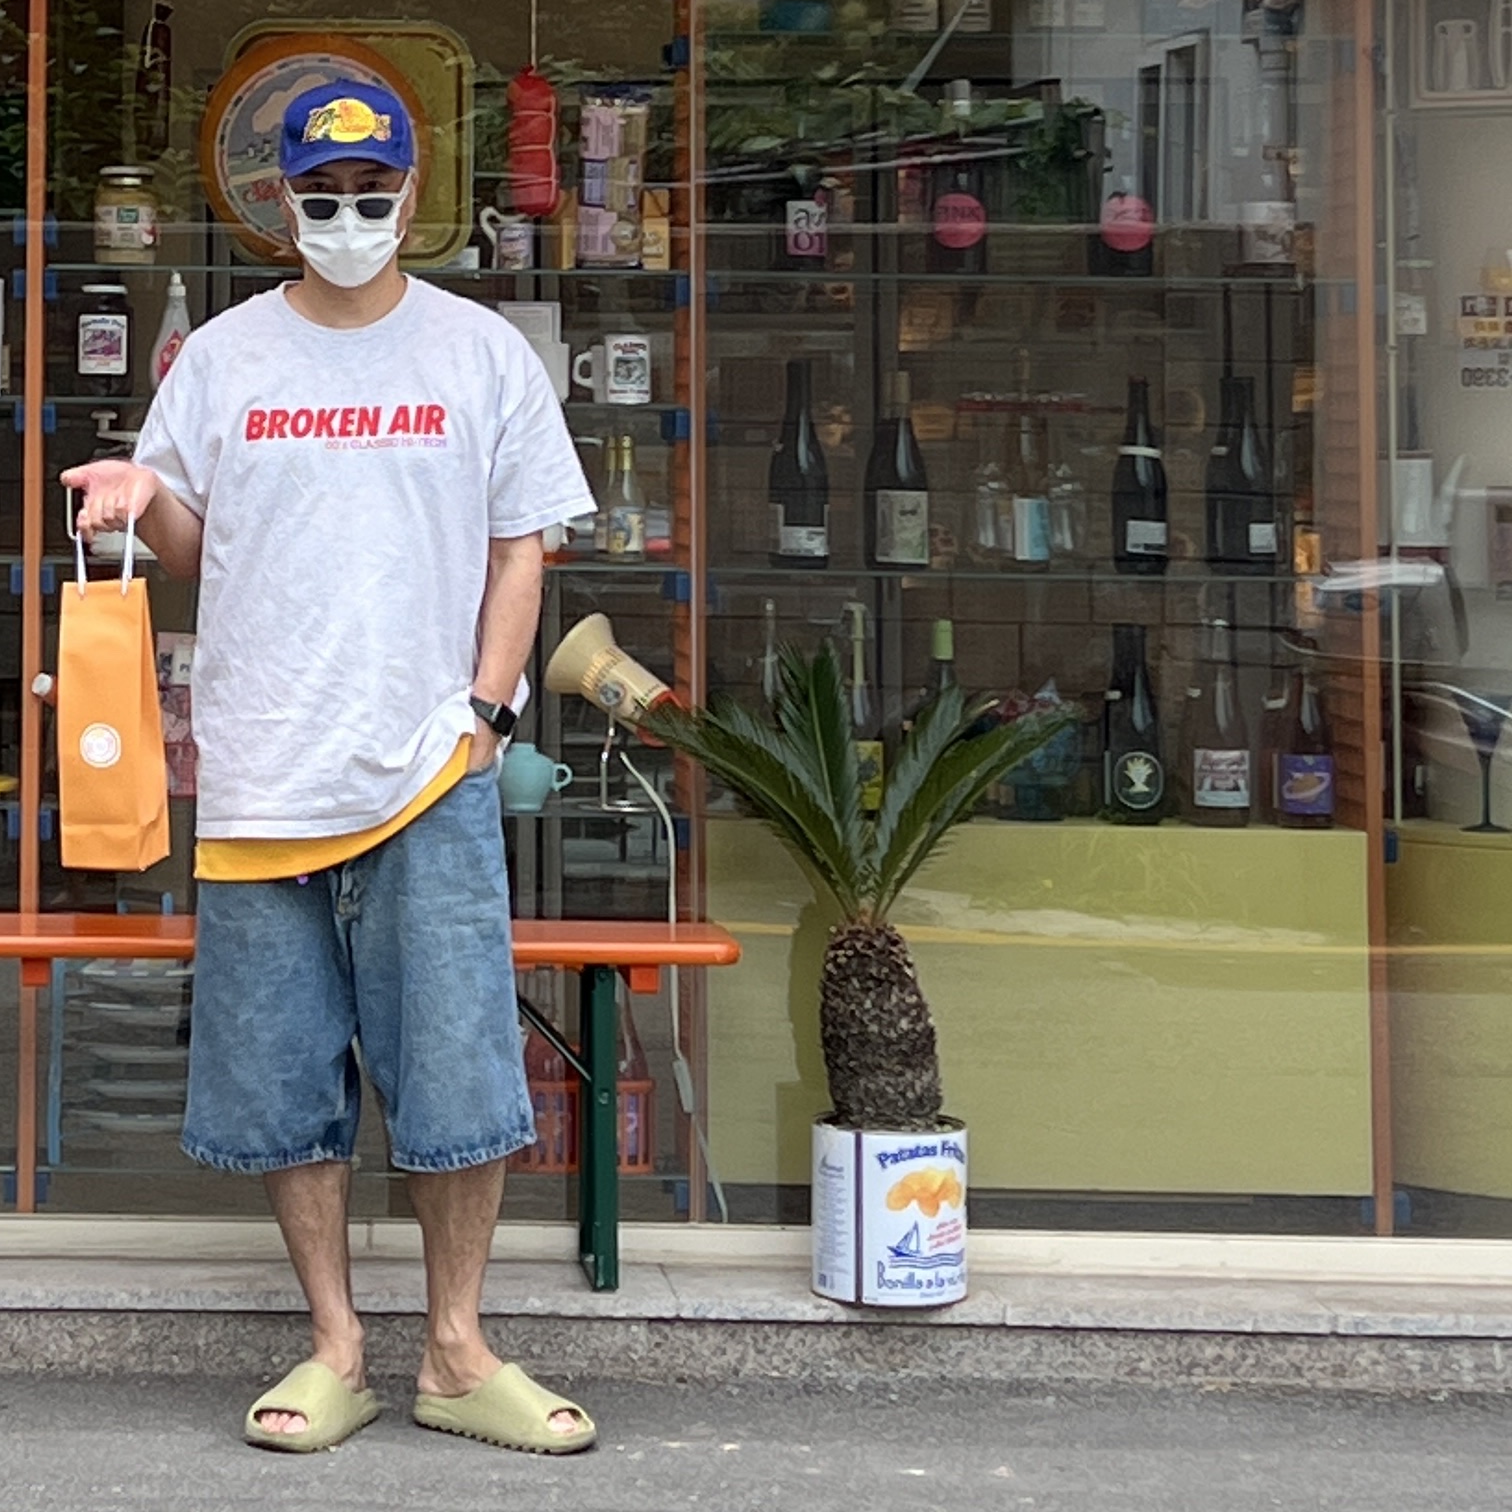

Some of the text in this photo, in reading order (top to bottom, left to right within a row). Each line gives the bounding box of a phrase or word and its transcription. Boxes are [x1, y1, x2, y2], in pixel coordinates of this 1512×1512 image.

[246, 404, 446, 442] BROKEN AIR
[875, 1145, 938, 1170] Patatas
[877, 1260, 923, 1289] Bonilla
